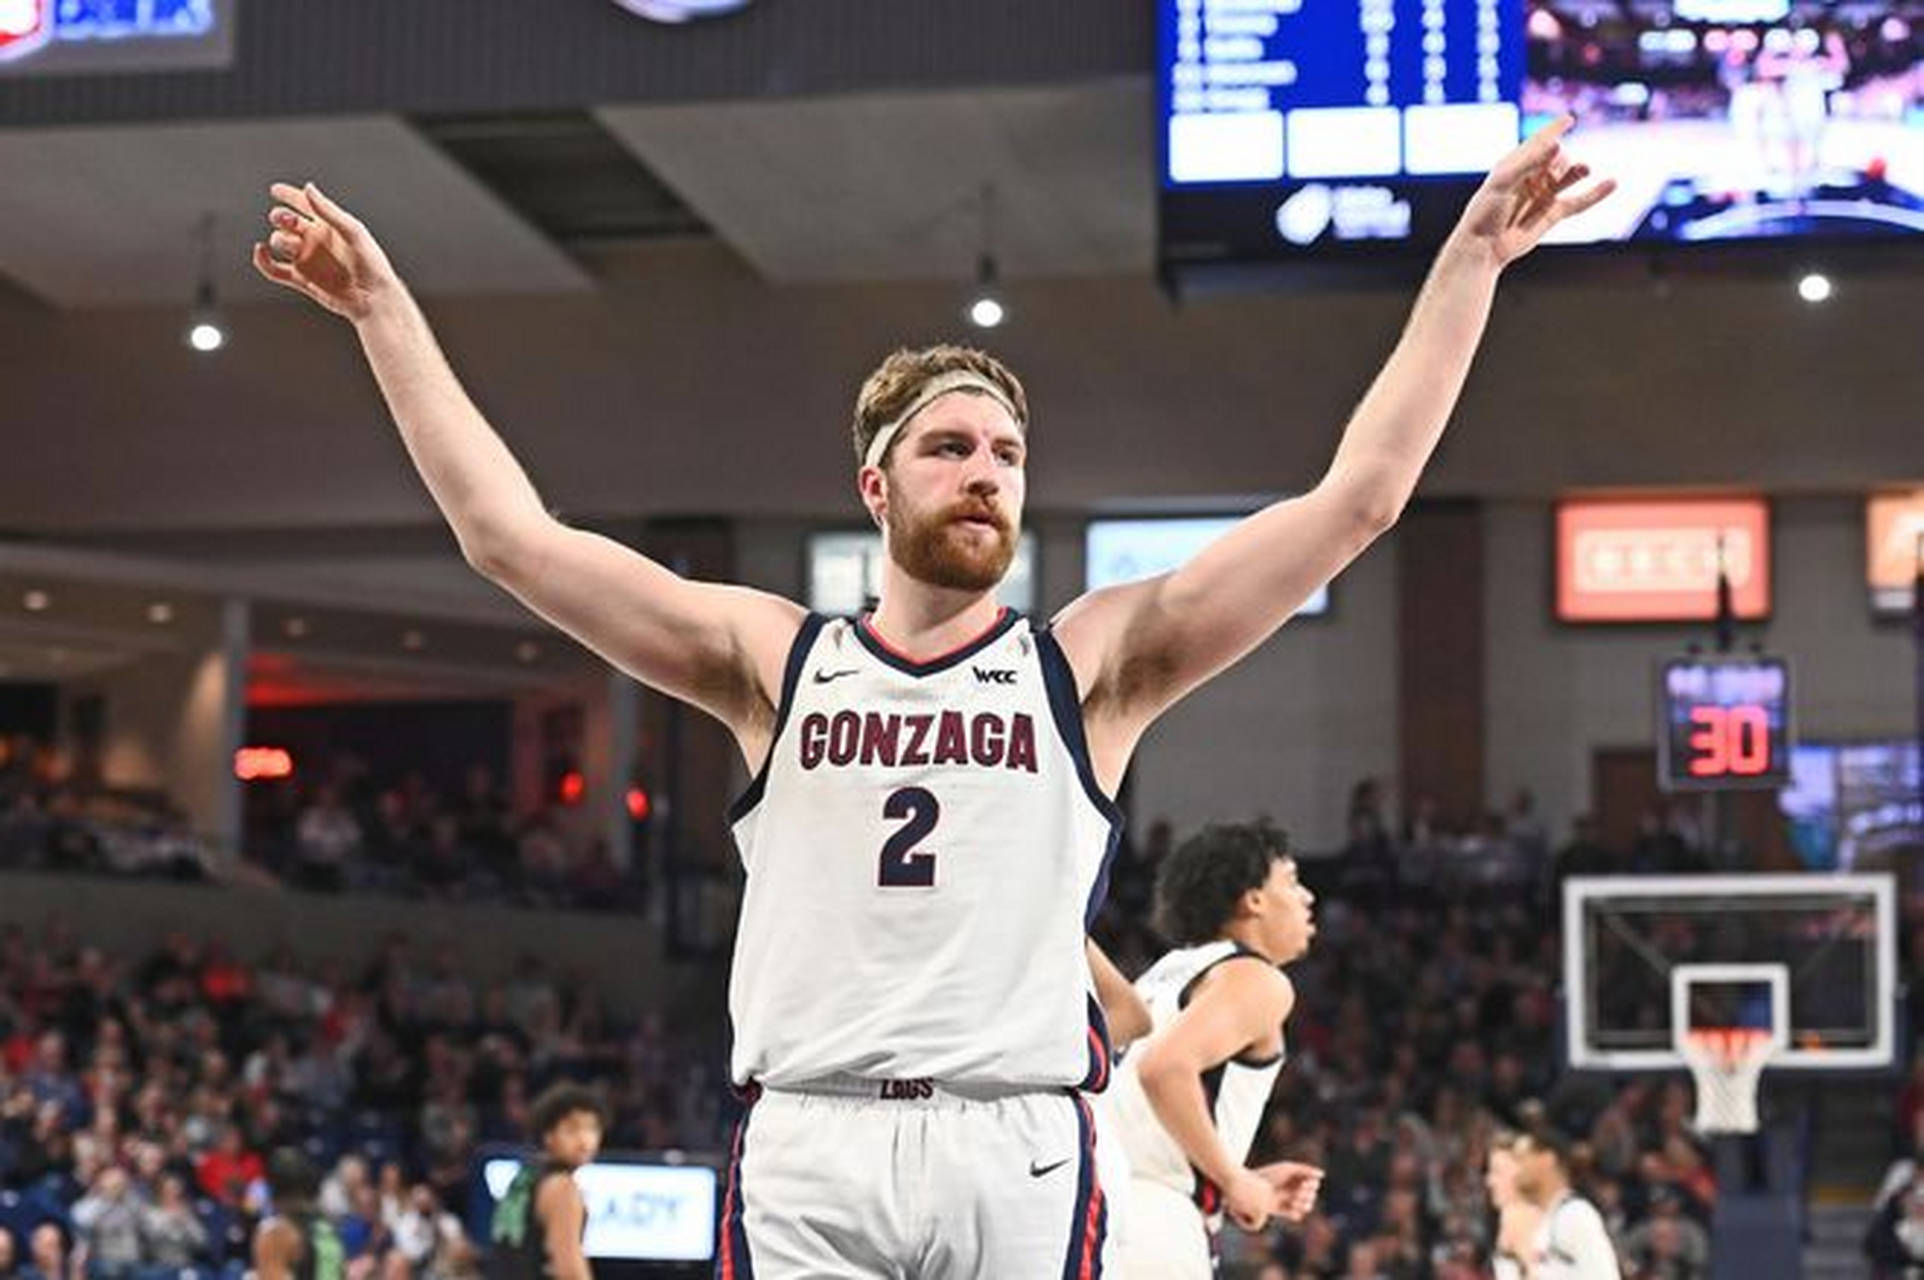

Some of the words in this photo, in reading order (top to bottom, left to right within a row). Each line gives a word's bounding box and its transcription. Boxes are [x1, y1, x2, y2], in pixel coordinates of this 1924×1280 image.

[972, 665, 1017, 685] WCC
[799, 709, 1039, 774] GONZAGA
[1689, 704, 1769, 777] 30
[878, 785, 941, 887] 2
